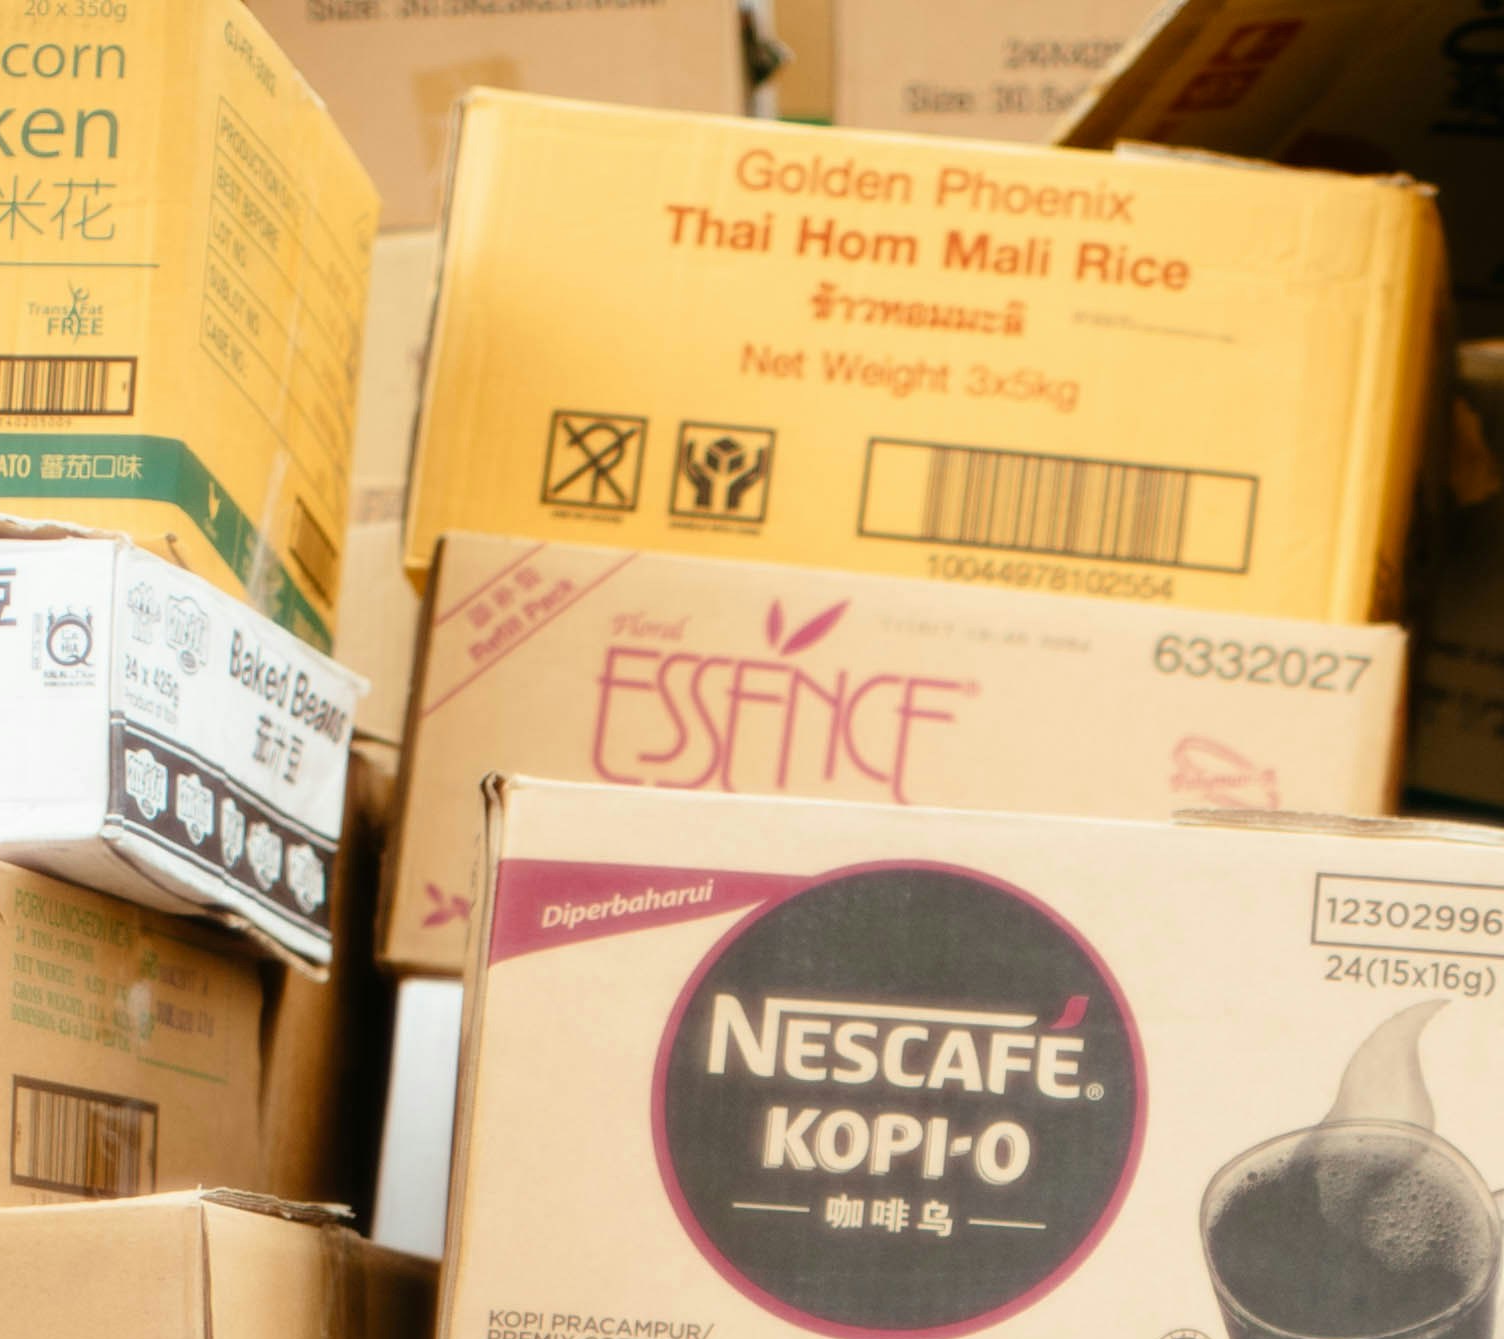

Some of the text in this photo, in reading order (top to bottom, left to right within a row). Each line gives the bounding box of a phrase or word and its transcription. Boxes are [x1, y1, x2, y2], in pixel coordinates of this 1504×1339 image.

[735, 148, 1136, 224] Golden Phoenix
[664, 204, 1192, 292] Thai Hom Mali Rice
[739, 343, 1081, 412] Net Weight 3x5kg
[40, 453, 144, 480] 番茄口味
[228, 629, 347, 746] Baked Beans
[1152, 631, 1373, 694] 6332027
[539, 877, 715, 930] Diperbaharui
[1322, 952, 1497, 995] 24(15x16g)
[760, 1105, 1032, 1185] KOPI-O
[824, 1193, 954, 1238] 咖啡乌
[488, 1310, 545, 1332] KOPI
